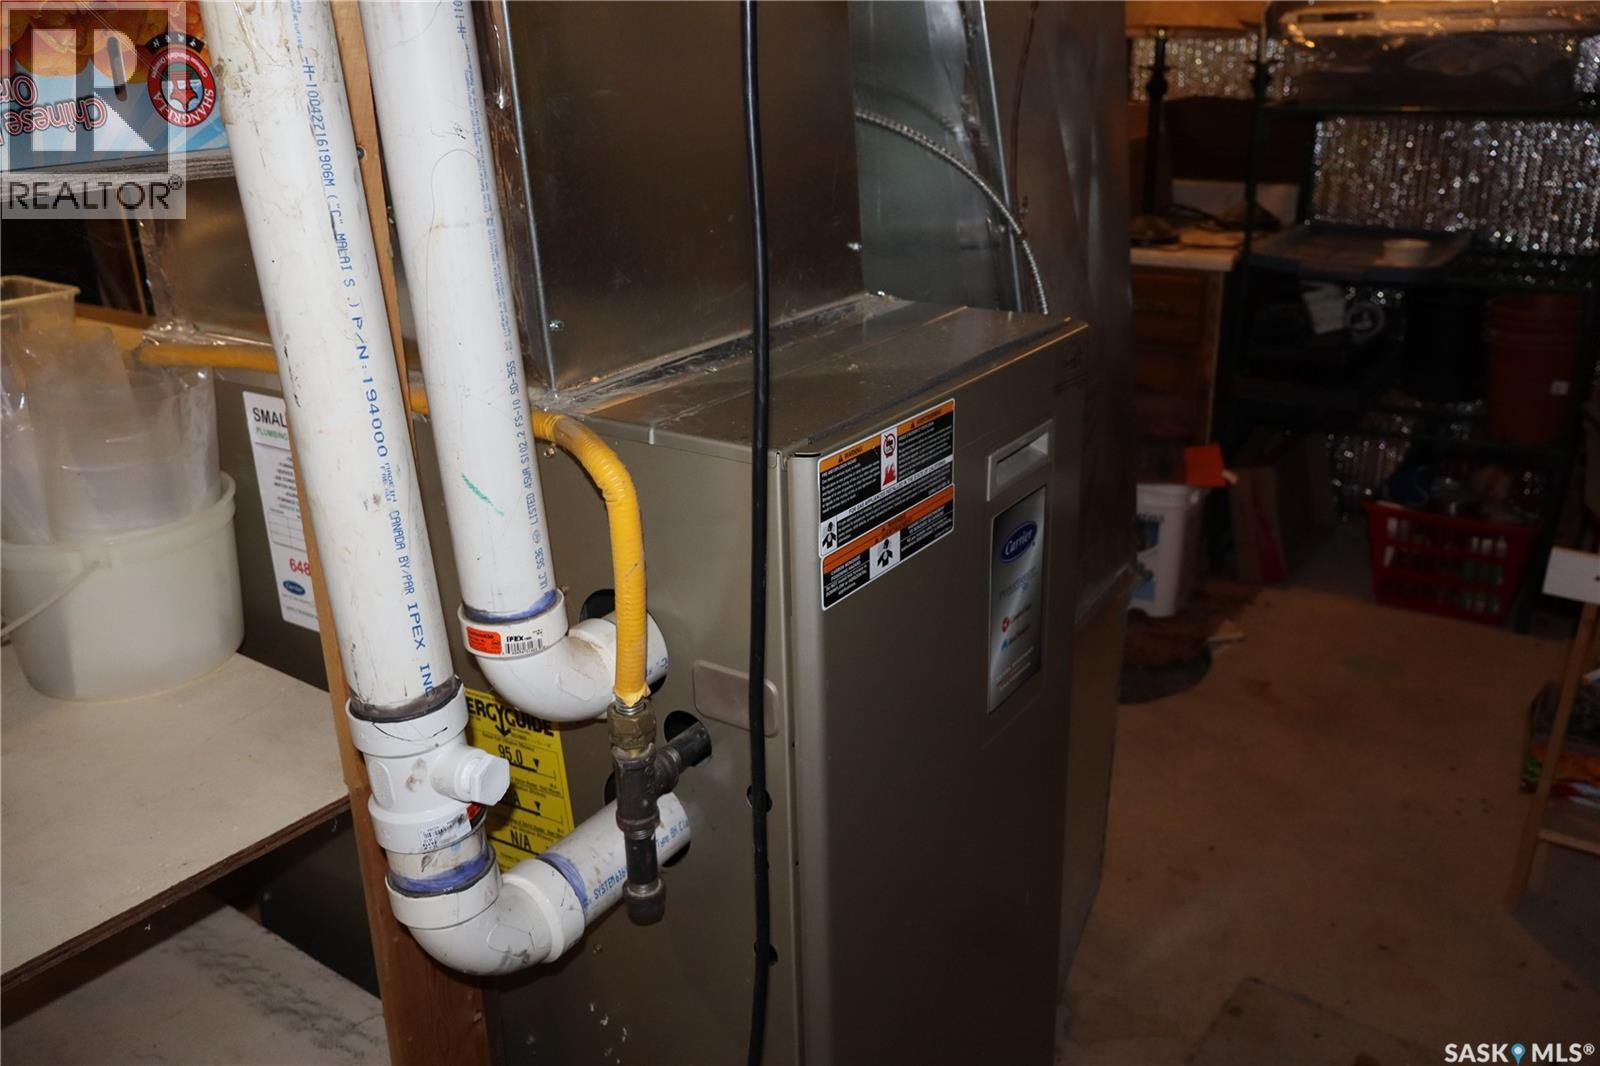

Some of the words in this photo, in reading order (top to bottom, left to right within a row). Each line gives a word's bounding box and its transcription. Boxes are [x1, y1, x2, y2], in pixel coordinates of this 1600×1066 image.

[0, 75, 39, 107] Or
[4, 96, 108, 135] Chinese
[526, 492, 539, 525] LISTED
[389, 509, 406, 551] CANADA
[408, 602, 426, 651] IPEX
[510, 829, 532, 851] N/A
